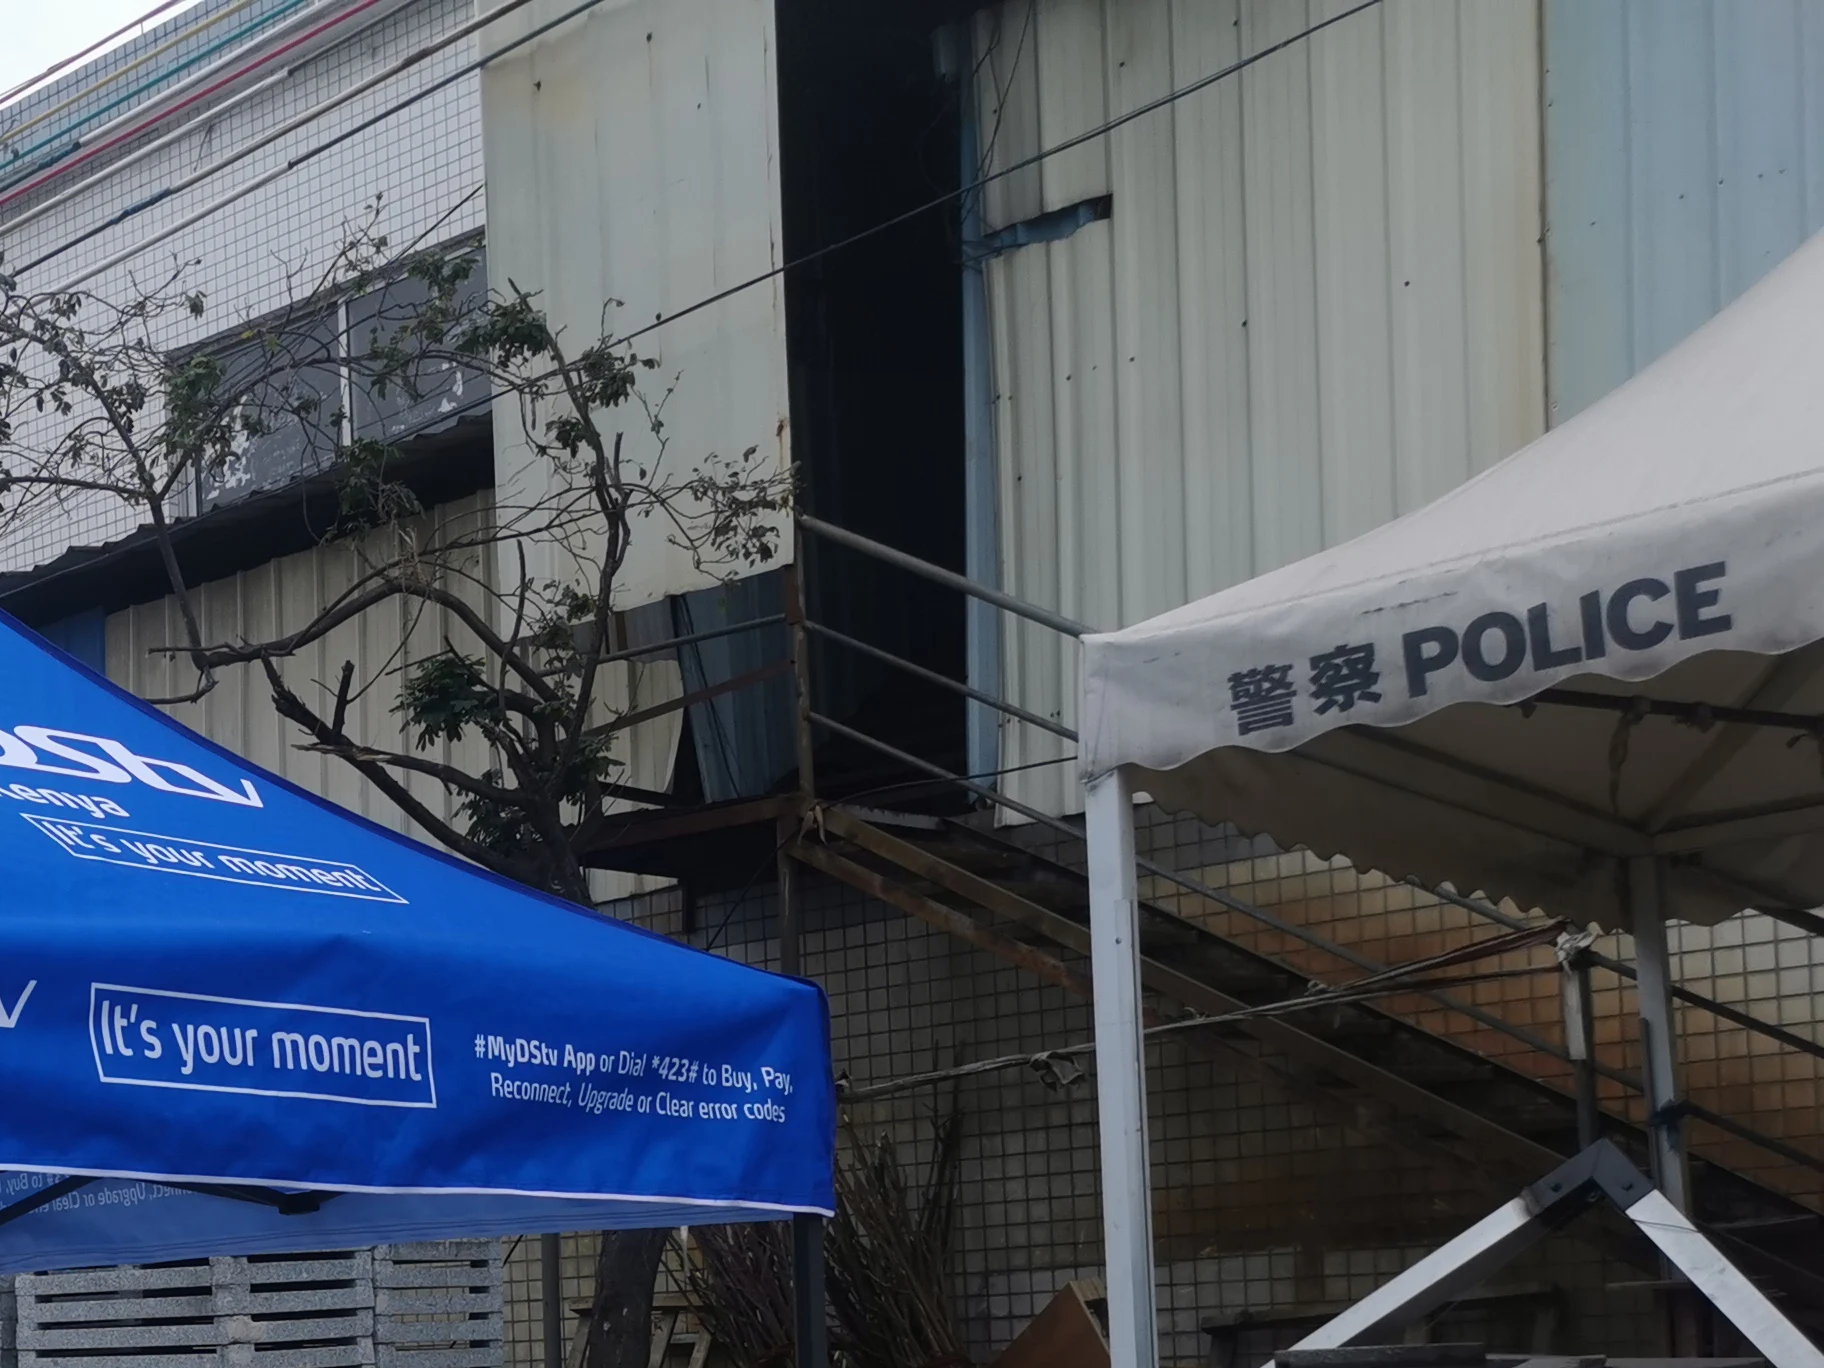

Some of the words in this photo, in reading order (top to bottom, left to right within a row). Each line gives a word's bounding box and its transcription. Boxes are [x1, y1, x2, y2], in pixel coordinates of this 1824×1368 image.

[1226, 643, 1383, 737] 警察
[1401, 561, 1732, 698] POLICE
[42, 820, 121, 853] It's
[120, 840, 216, 870] your
[218, 853, 381, 892] moment
[101, 999, 162, 1060] It's
[172, 1022, 257, 1074] your
[272, 1030, 422, 1082] moment
[475, 1034, 558, 1068] #MyDStv
[563, 1044, 595, 1076] App
[599, 1054, 615, 1073] or
[618, 1050, 647, 1077] Dial
[702, 1063, 717, 1086] to
[721, 1064, 758, 1093] Buy,
[760, 1066, 793, 1095] Pay,
[490, 1072, 572, 1107] Reconnect,
[577, 1082, 634, 1114] Upgrade
[637, 1095, 652, 1113] or
[656, 1091, 694, 1118] Clear
[698, 1101, 738, 1119] error
[744, 1098, 785, 1123] codes
